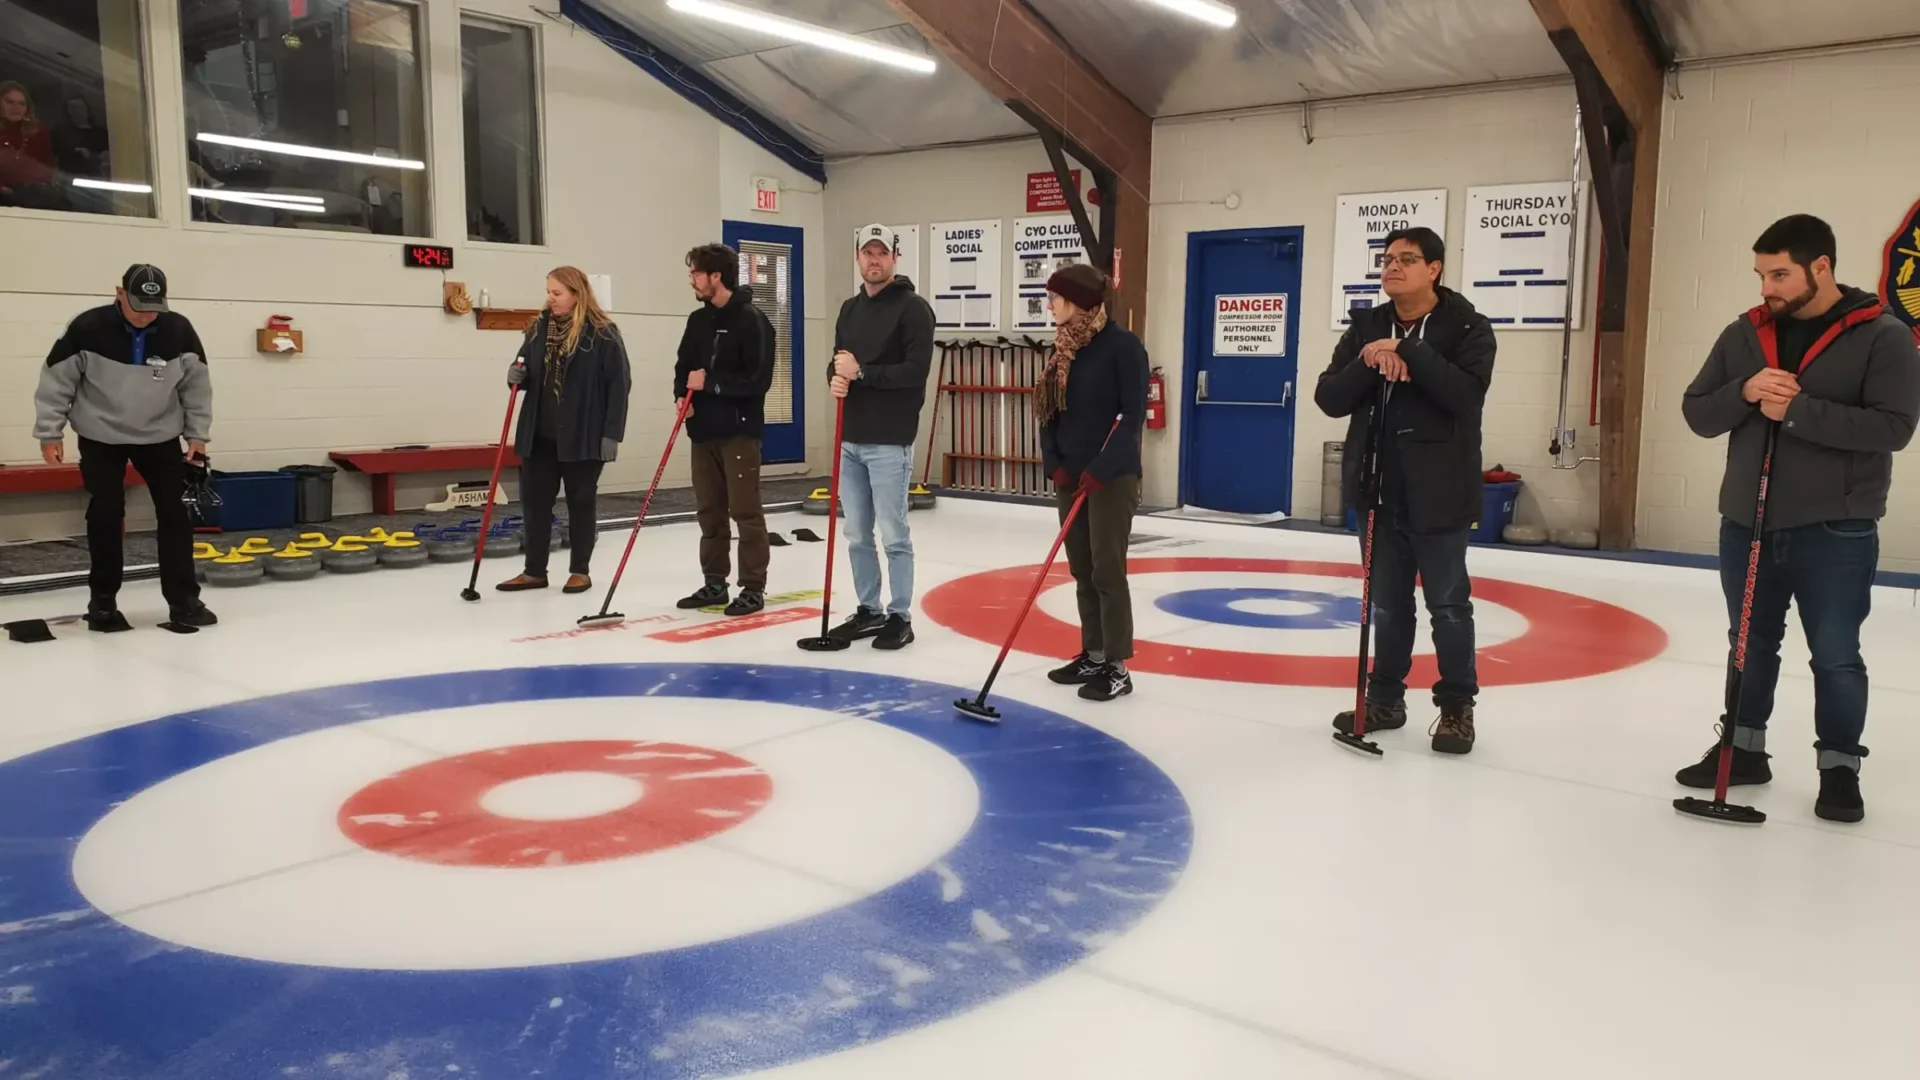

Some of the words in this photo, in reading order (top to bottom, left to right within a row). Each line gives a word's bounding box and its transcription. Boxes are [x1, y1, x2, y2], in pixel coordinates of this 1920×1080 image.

[757, 190, 777, 210] EXIT
[1486, 195, 1567, 212] THURSDAY
[1358, 203, 1419, 217] MONDAY
[1366, 220, 1409, 233] MIXED
[1480, 215, 1534, 229] SOCIAL
[1538, 212, 1571, 226] CYO
[945, 229, 984, 241] LADIES'
[1025, 226, 1047, 237] CYO
[1049, 224, 1080, 235] CLUB
[945, 243, 983, 255] SOCIAL
[1014, 237, 1086, 252] COMPETITIV
[413, 247, 441, 266] 4:24
[1219, 299, 1283, 313] DANGER
[1223, 325, 1277, 333] AUTHORIZED
[1223, 335, 1273, 343] PERSONNEL
[1237, 344, 1260, 352] ONLY
[1733, 540, 1762, 673] TOURNAMENT
